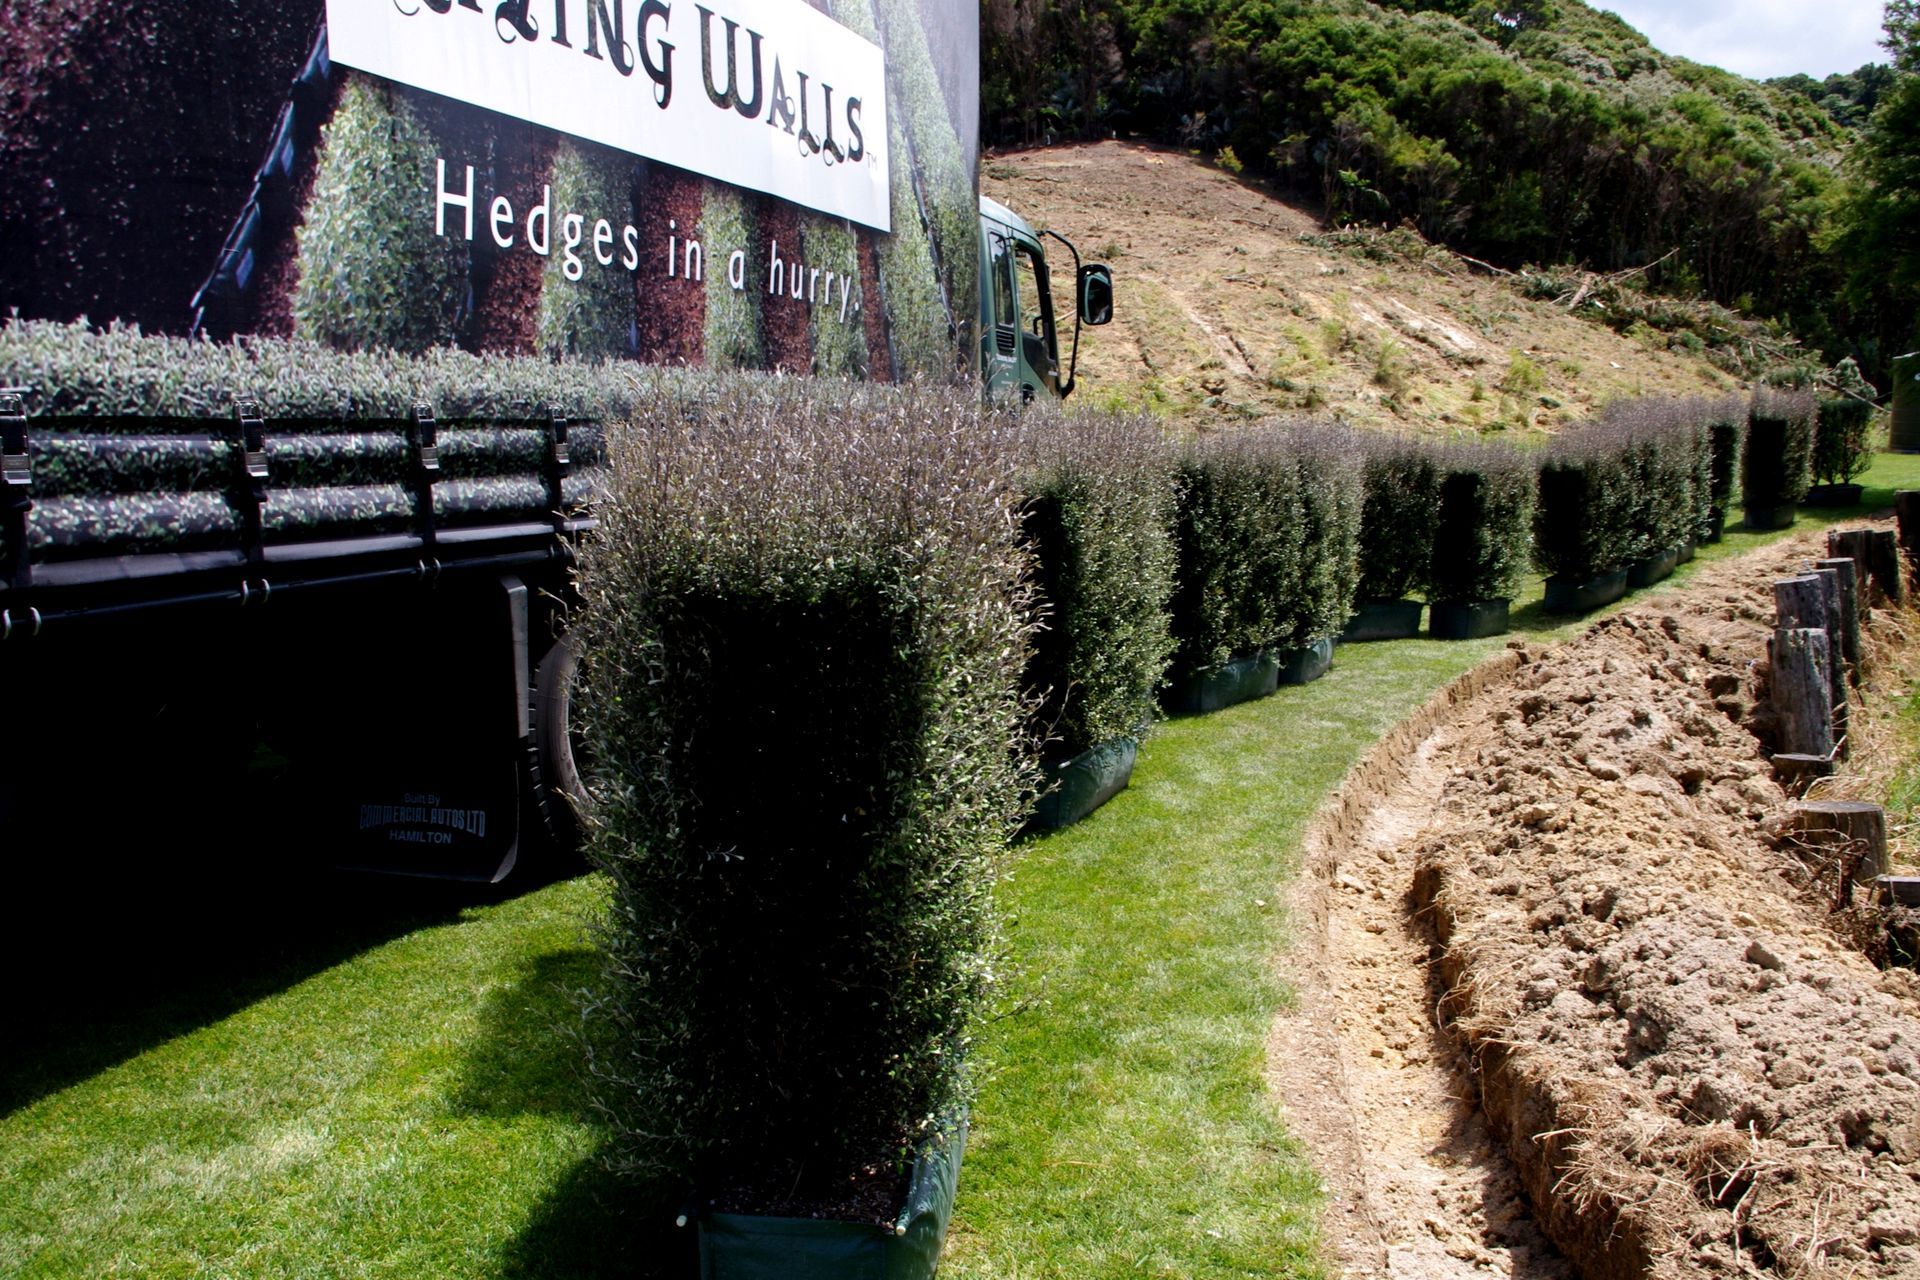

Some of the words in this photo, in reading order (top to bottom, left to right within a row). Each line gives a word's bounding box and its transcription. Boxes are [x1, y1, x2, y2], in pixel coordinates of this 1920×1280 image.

[694, 3, 864, 167] WALLS
[435, 158, 639, 282] Hedges
[668, 220, 701, 281] in
[728, 249, 746, 290] a
[769, 240, 862, 322] hurry.
[404, 792, 425, 804] Built
[427, 794, 441, 807] By
[359, 804, 428, 829] COMMERCIAL
[430, 808, 464, 830] AUTOS
[466, 809, 486, 838] LTD
[389, 829, 452, 844] HAMILTON
